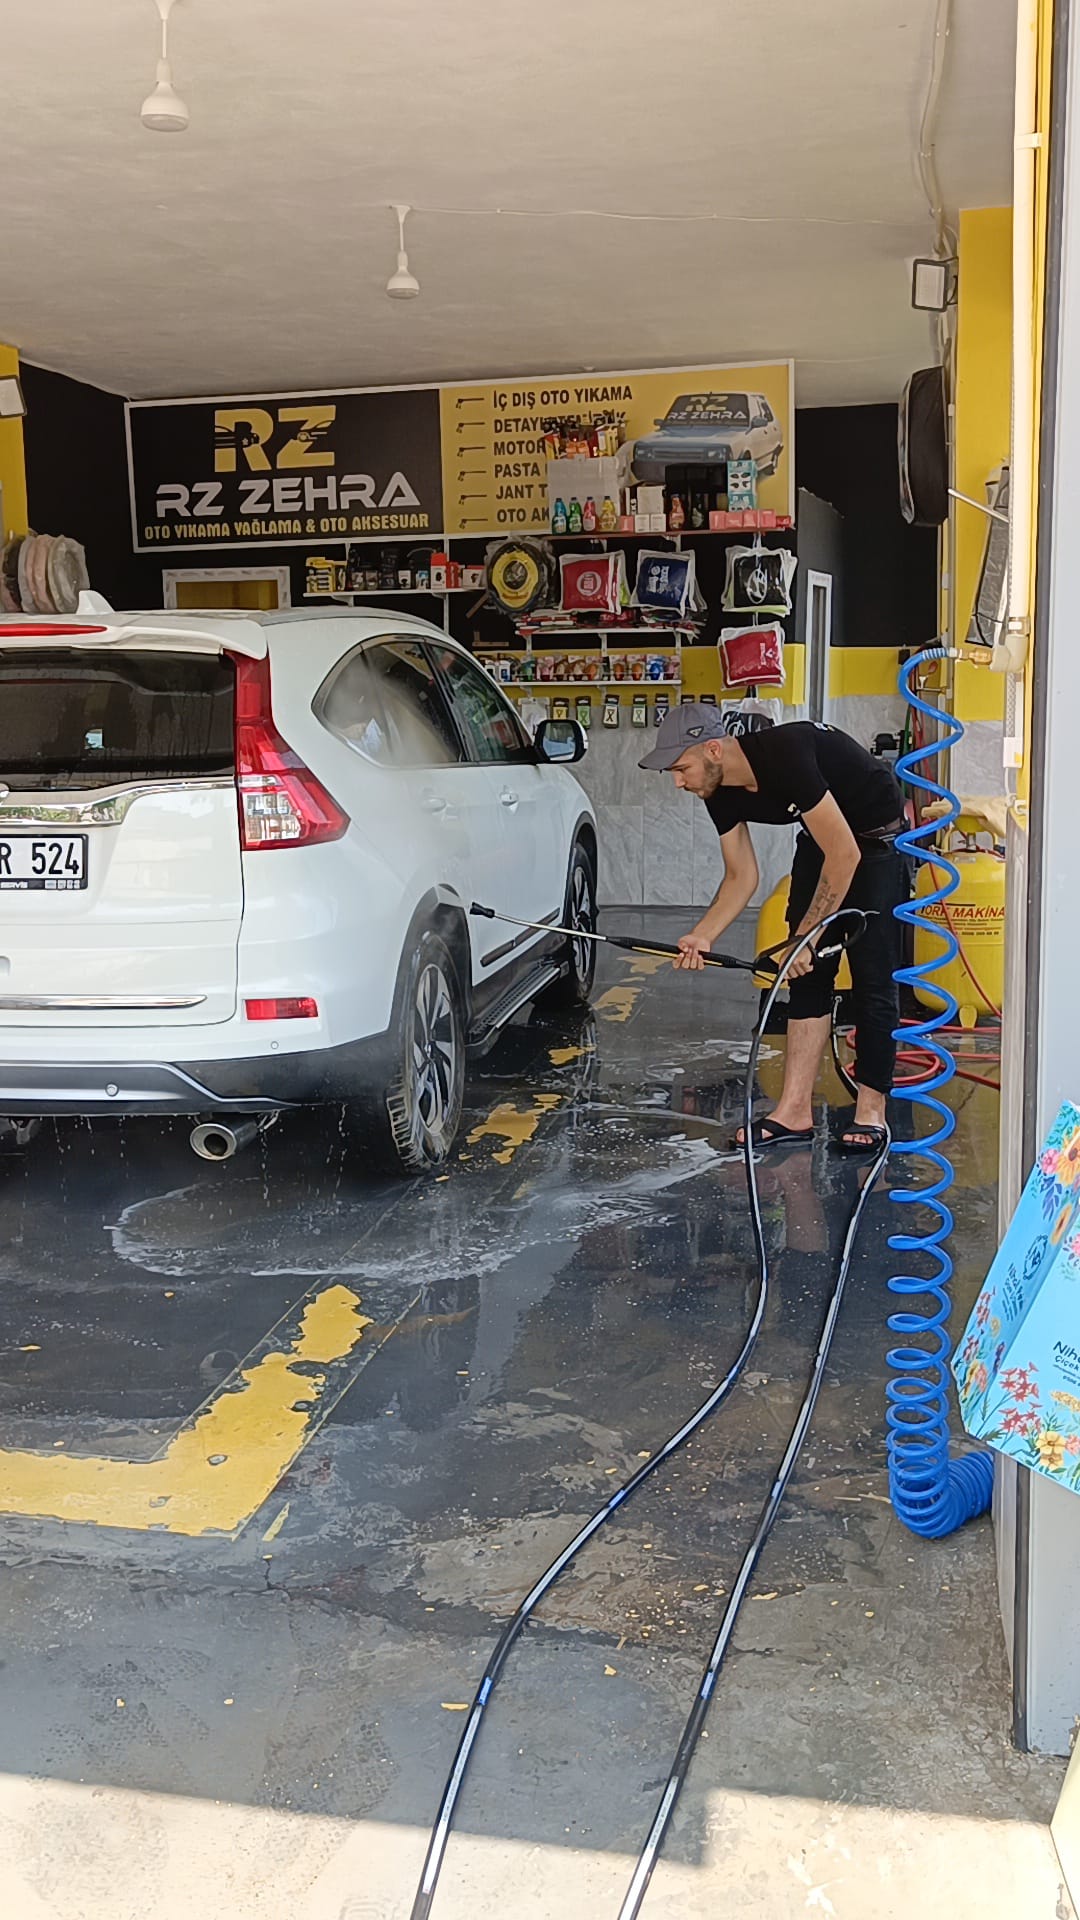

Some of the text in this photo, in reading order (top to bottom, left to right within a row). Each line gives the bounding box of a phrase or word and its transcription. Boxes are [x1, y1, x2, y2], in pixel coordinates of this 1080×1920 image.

[492, 385, 632, 410] İÇ DIŞ OTO YIKAMA
[667, 410, 747, 420] RZ ZEHRA
[493, 416, 548, 434] DETAYL
[214, 405, 336, 473] RZ
[493, 439, 546, 456] MOTOR
[494, 462, 541, 478] PASTA
[155, 471, 421, 518] RZ ZEHRA
[496, 484, 534, 499] JANT
[497, 506, 550, 523] OTO AK
[144, 513, 429, 540] OTO YIKAMA YAĞLAMA & OTO AKSESUAR
[31, 842, 80, 875] 524
[952, 905, 1005, 919] MAKİNA
